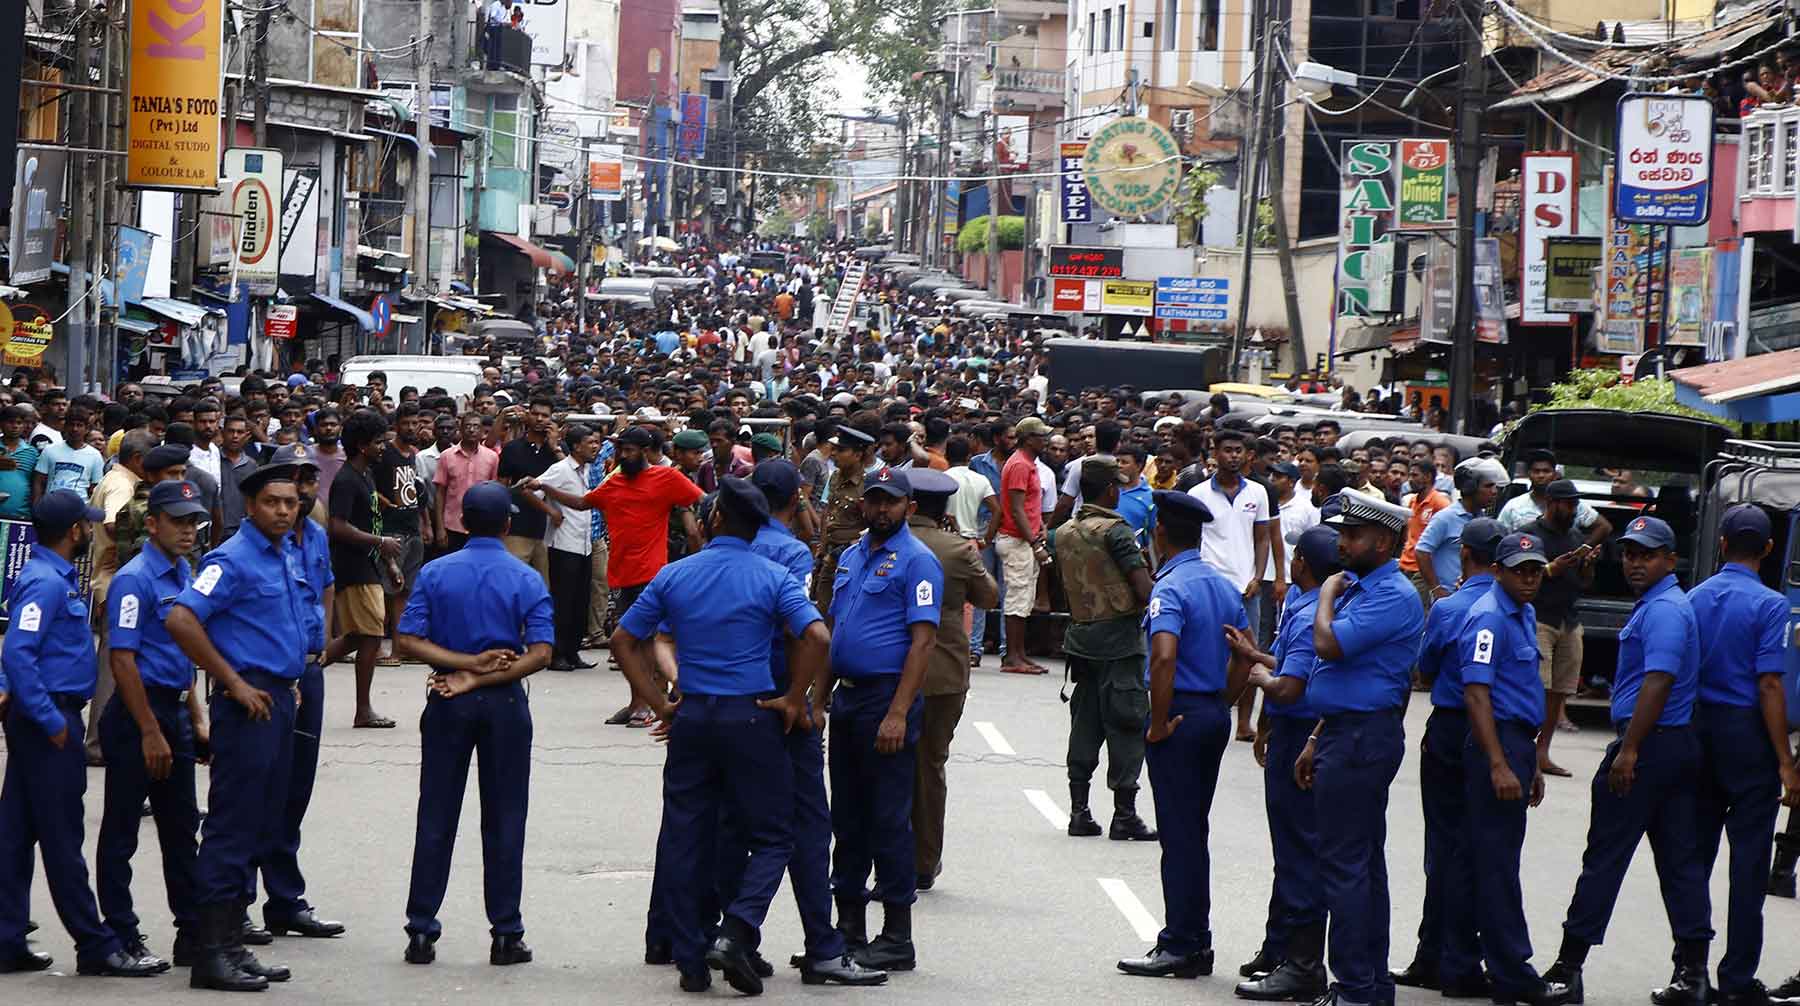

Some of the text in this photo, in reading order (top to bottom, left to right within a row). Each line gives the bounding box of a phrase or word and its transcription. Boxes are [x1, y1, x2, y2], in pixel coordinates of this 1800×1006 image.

[133, 96, 218, 115] TANIA'S FOTO
[182, 119, 198, 133] Ltd
[132, 139, 210, 152] DIGITAL STUDIO
[169, 156, 178, 166] &
[1629, 148, 1703, 164] රන් ණය
[141, 166, 206, 179] COLOUR LAB
[1418, 172, 1443, 186] Easy
[1638, 167, 1694, 181] සේවාව
[1065, 158, 1086, 220] HOTEL
[1403, 178, 1443, 202] Dinner
[242, 190, 258, 253] Glidden
[1201, 310, 1224, 319] ROAD
[18, 525, 27, 542] Card
